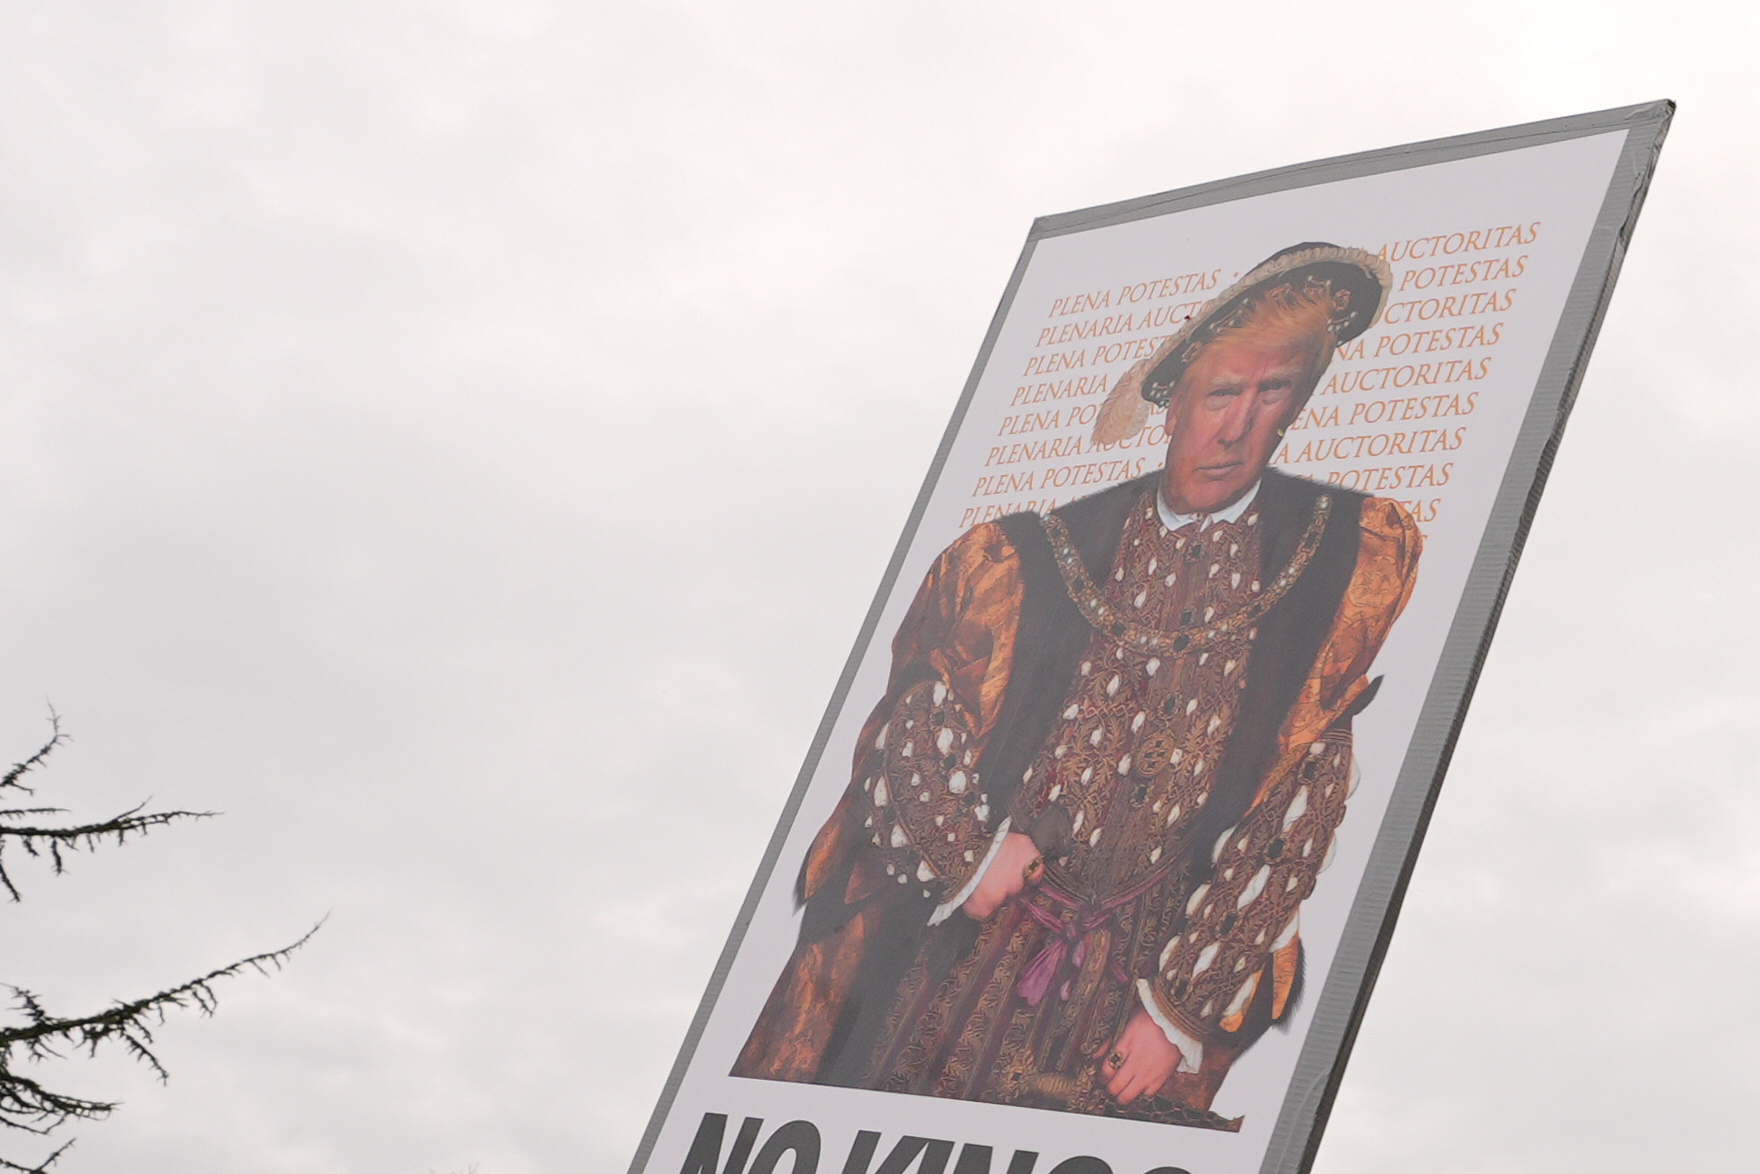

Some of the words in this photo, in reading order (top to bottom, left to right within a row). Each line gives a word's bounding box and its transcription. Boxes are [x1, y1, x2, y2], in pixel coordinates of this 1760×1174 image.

[1397, 255, 1529, 292] POTESTAS
[1047, 290, 1111, 318] PLENA
[1116, 268, 1222, 306] POTESTAS
[1035, 313, 1134, 348] PLENARIA
[1373, 322, 1504, 358] POTESTAS
[1022, 349, 1086, 377] PLENA
[1319, 357, 1492, 396] AUCTORITAS
[1009, 374, 1109, 407] PLENARIA
[997, 410, 1061, 437] PLENA
[1347, 392, 1479, 425] POTESTAS
[985, 436, 1082, 467] PLENARIA
[1294, 427, 1467, 464] AUCTORITAS
[972, 471, 1035, 498] PLENA
[1040, 457, 1147, 489] POTESTAS
